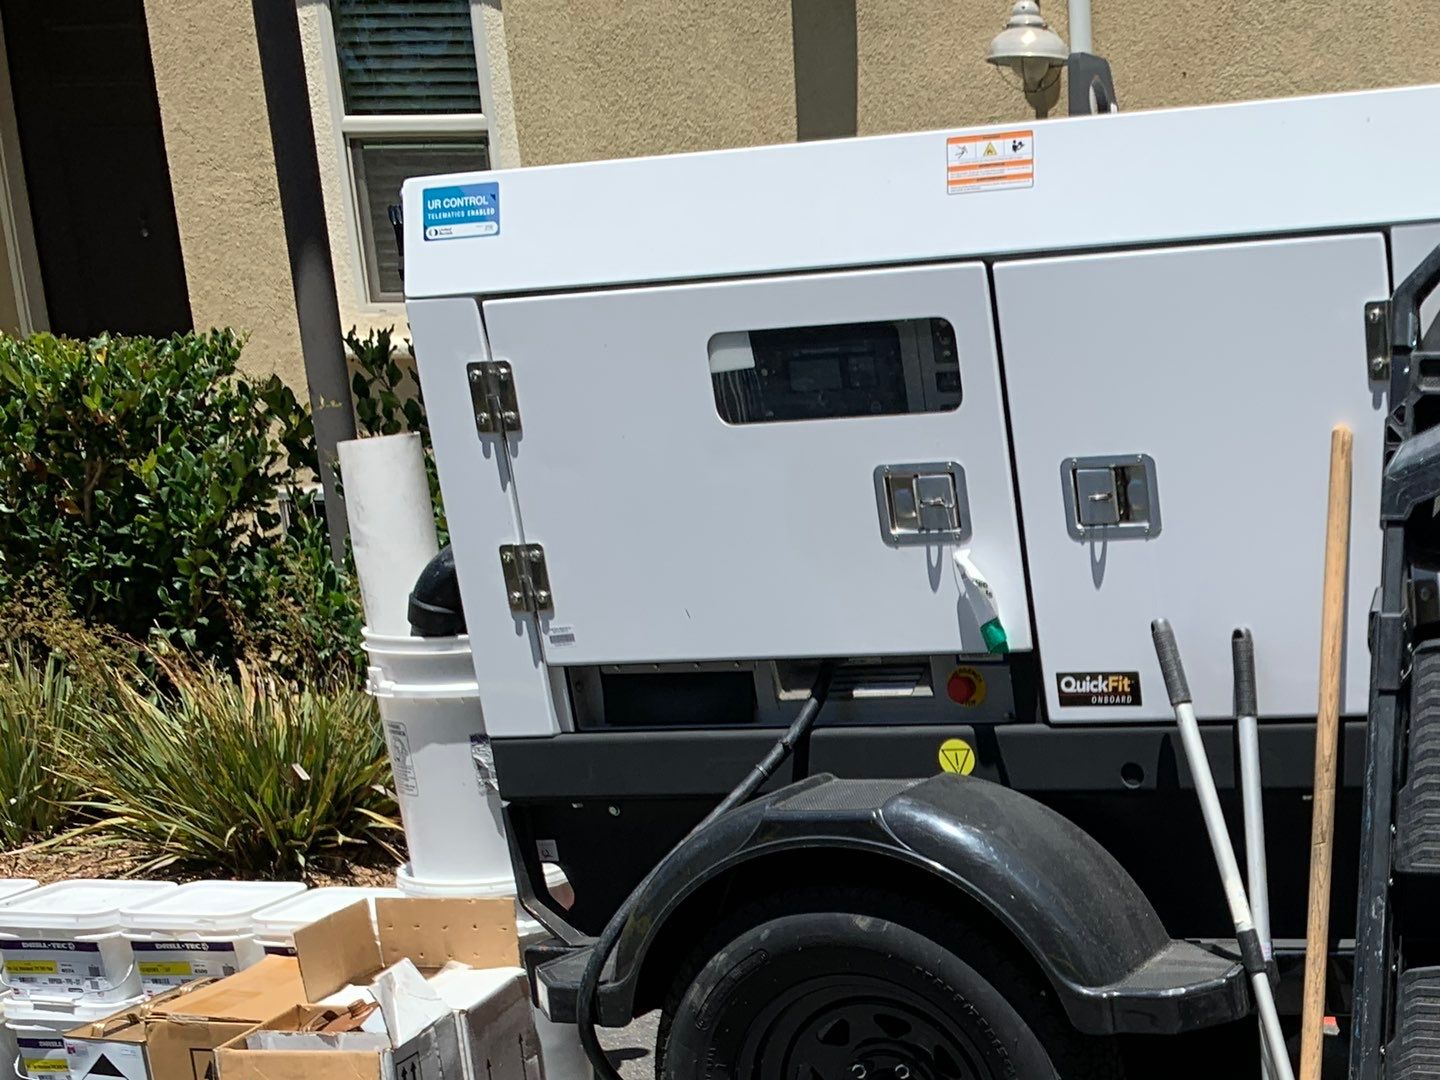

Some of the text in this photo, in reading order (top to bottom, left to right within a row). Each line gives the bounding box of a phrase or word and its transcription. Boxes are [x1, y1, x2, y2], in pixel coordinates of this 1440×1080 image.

[427, 195, 489, 210] UR CONTROL
[427, 207, 495, 220] TELEMATICS ENABLED
[1060, 674, 1131, 693] QuickFit
[1091, 695, 1132, 704] ONBOARD
